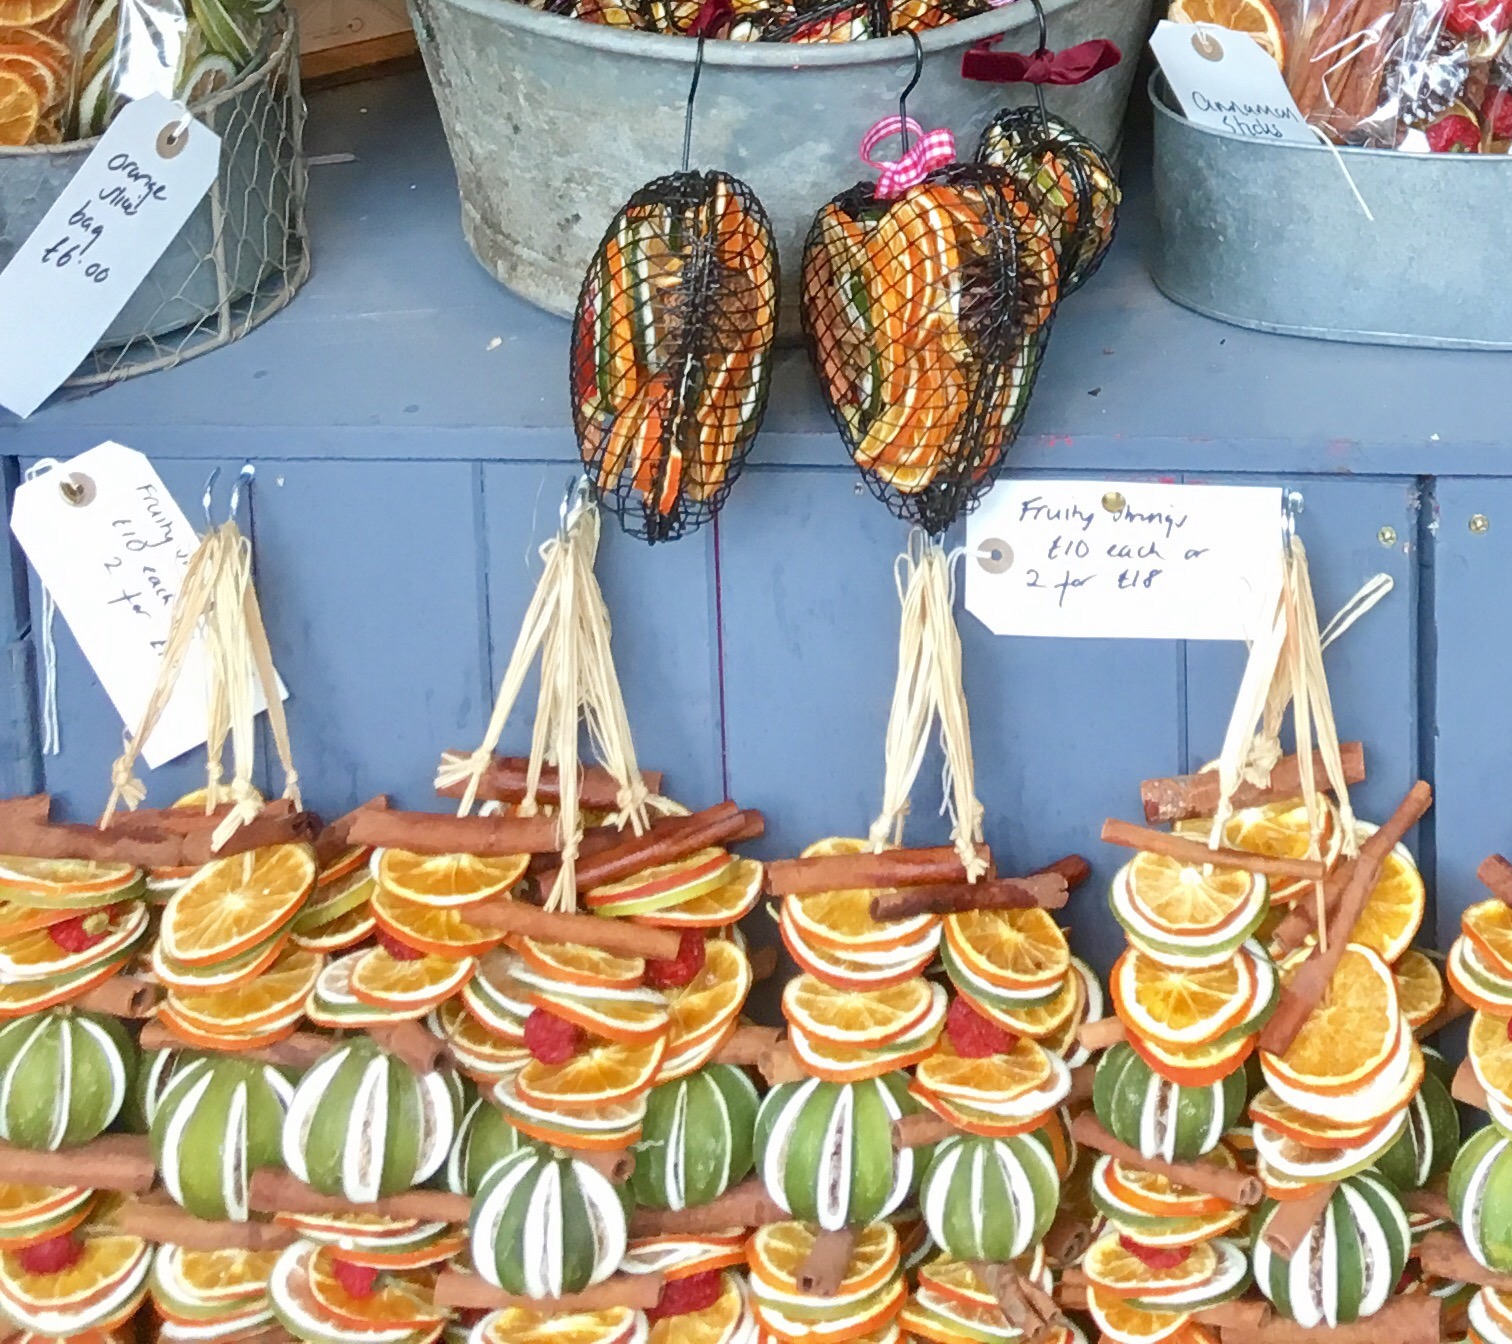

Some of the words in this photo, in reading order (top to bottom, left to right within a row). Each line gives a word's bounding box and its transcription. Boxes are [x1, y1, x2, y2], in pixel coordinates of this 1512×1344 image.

[68, 200, 104, 256] bag
[1019, 496, 1095, 532] Fruity
[103, 556, 122, 576] 2
[1047, 535, 1090, 561] £10
[1106, 541, 1167, 561] each
[1183, 547, 1211, 561] or
[107, 589, 152, 619] for
[142, 565, 174, 607] each
[1025, 568, 1048, 590] 2
[1053, 569, 1098, 609] for
[1116, 568, 1164, 591] £18
